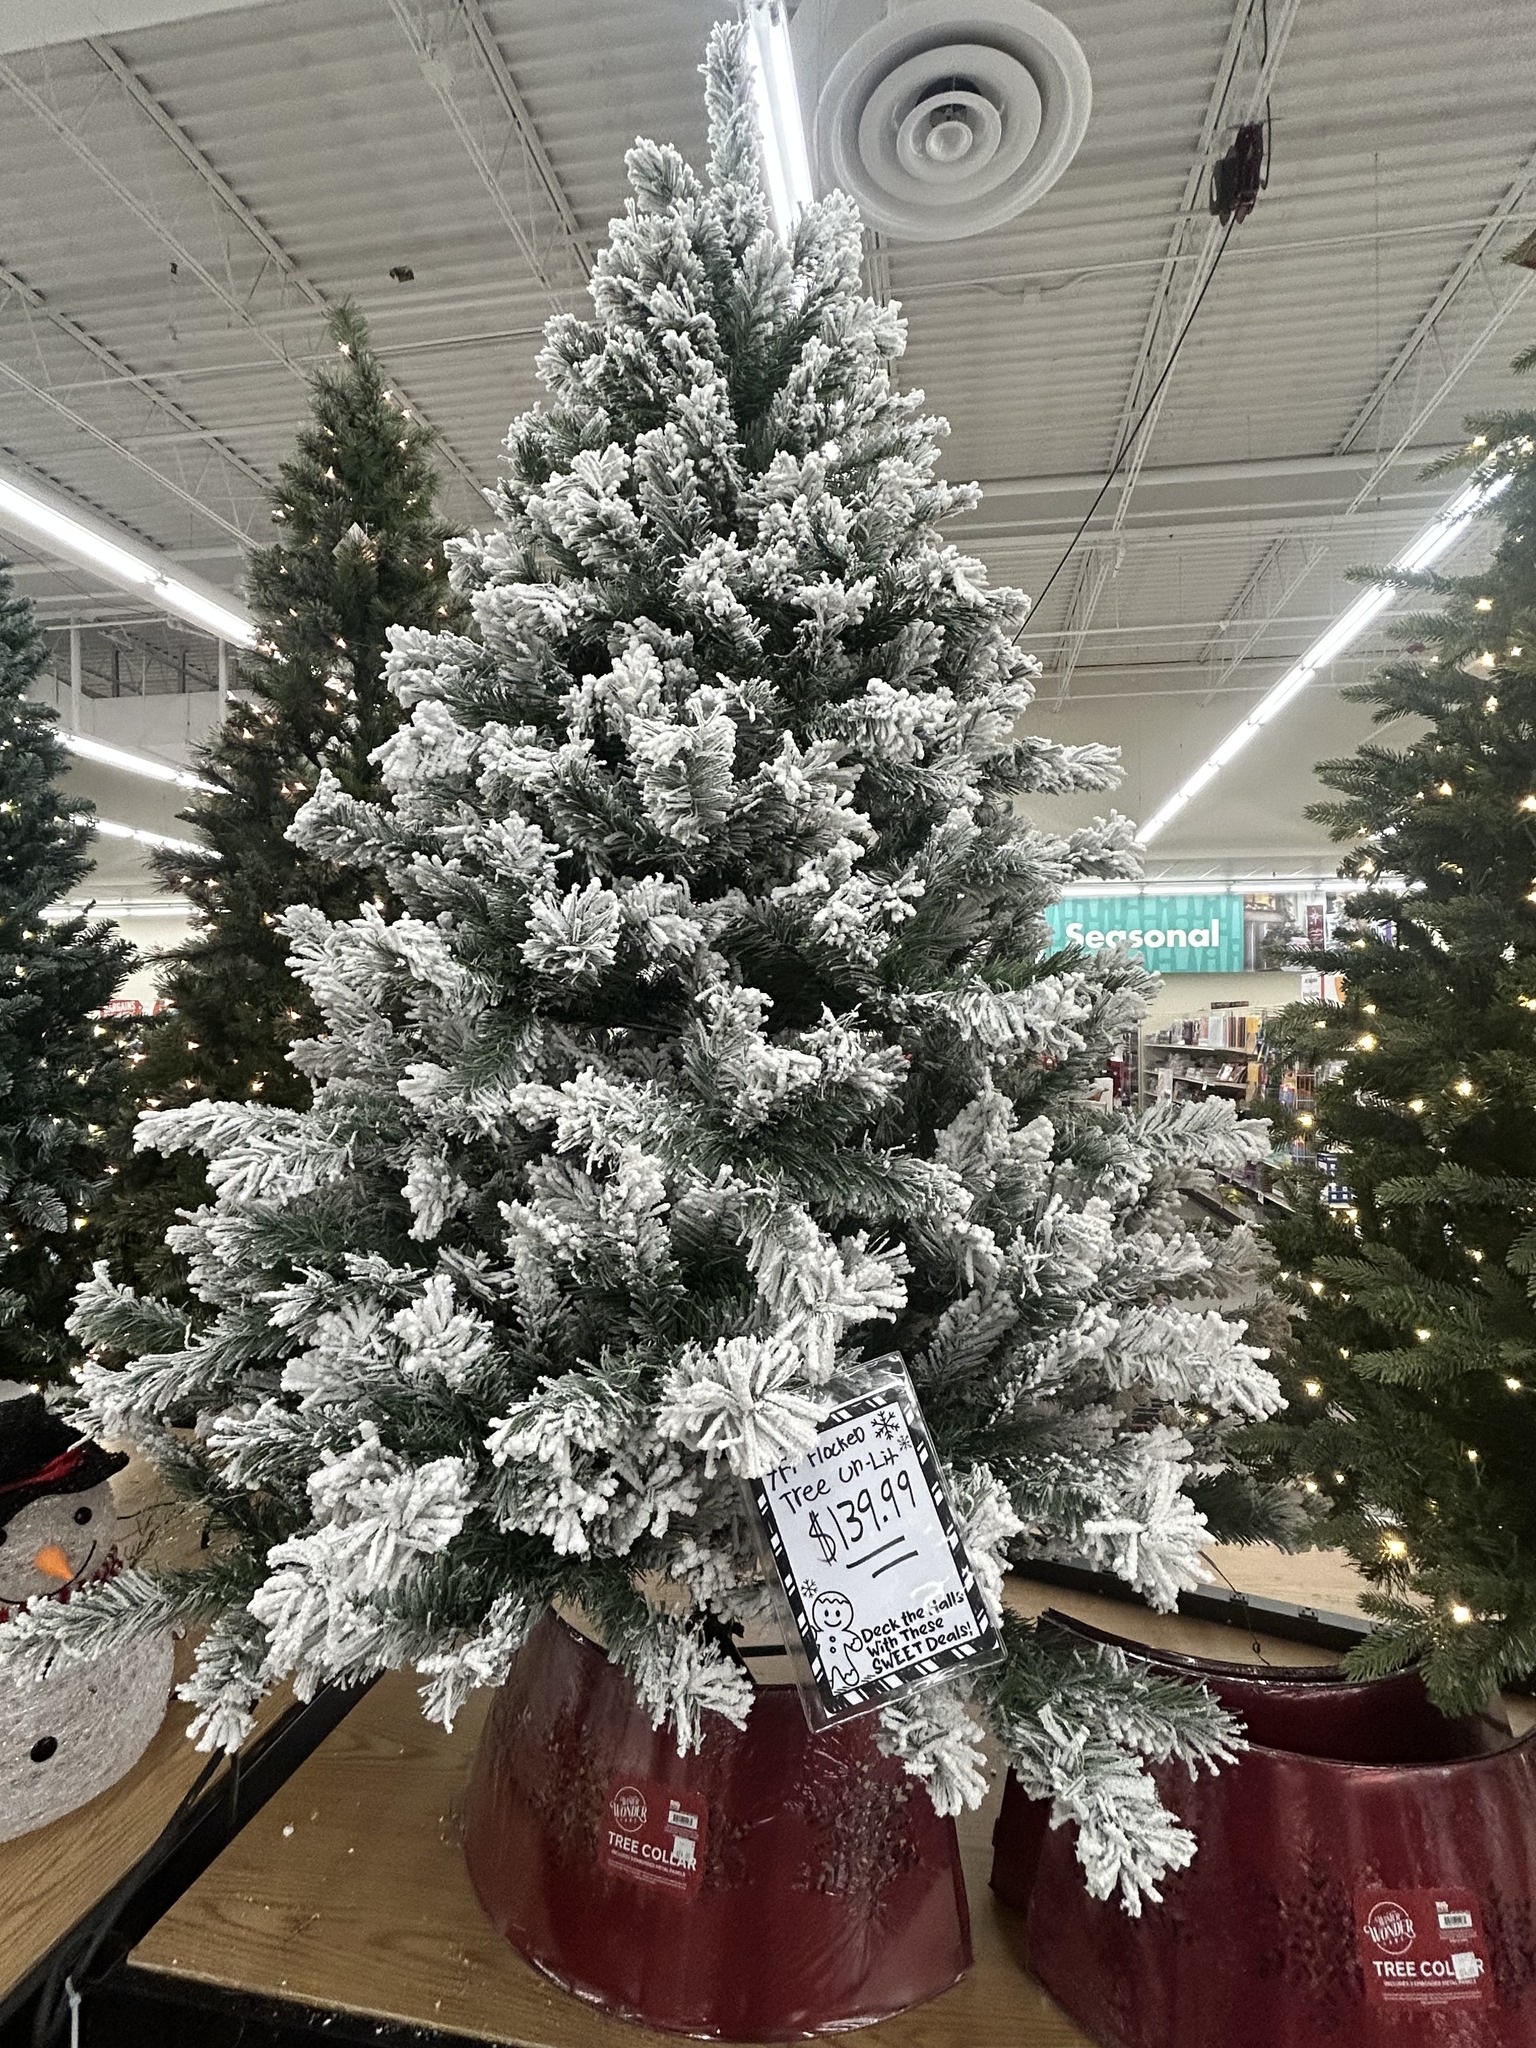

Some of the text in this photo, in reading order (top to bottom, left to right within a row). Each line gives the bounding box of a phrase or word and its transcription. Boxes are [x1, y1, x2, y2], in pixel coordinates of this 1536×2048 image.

[1065, 918, 1219, 949] Seasonal
[779, 1479, 831, 1514] Tree
[809, 1470, 916, 1567] $139.99
[861, 1618, 901, 1643] Deck
[901, 1607, 925, 1627] the
[866, 1617, 944, 1658] With These
[872, 1621, 973, 1674] SWEET Deals!
[608, 1831, 640, 1854] TREE
[1363, 1919, 1416, 1943] WONDER
[1372, 1960, 1417, 1978] TREE
[1420, 1958, 1485, 1978] COLR
